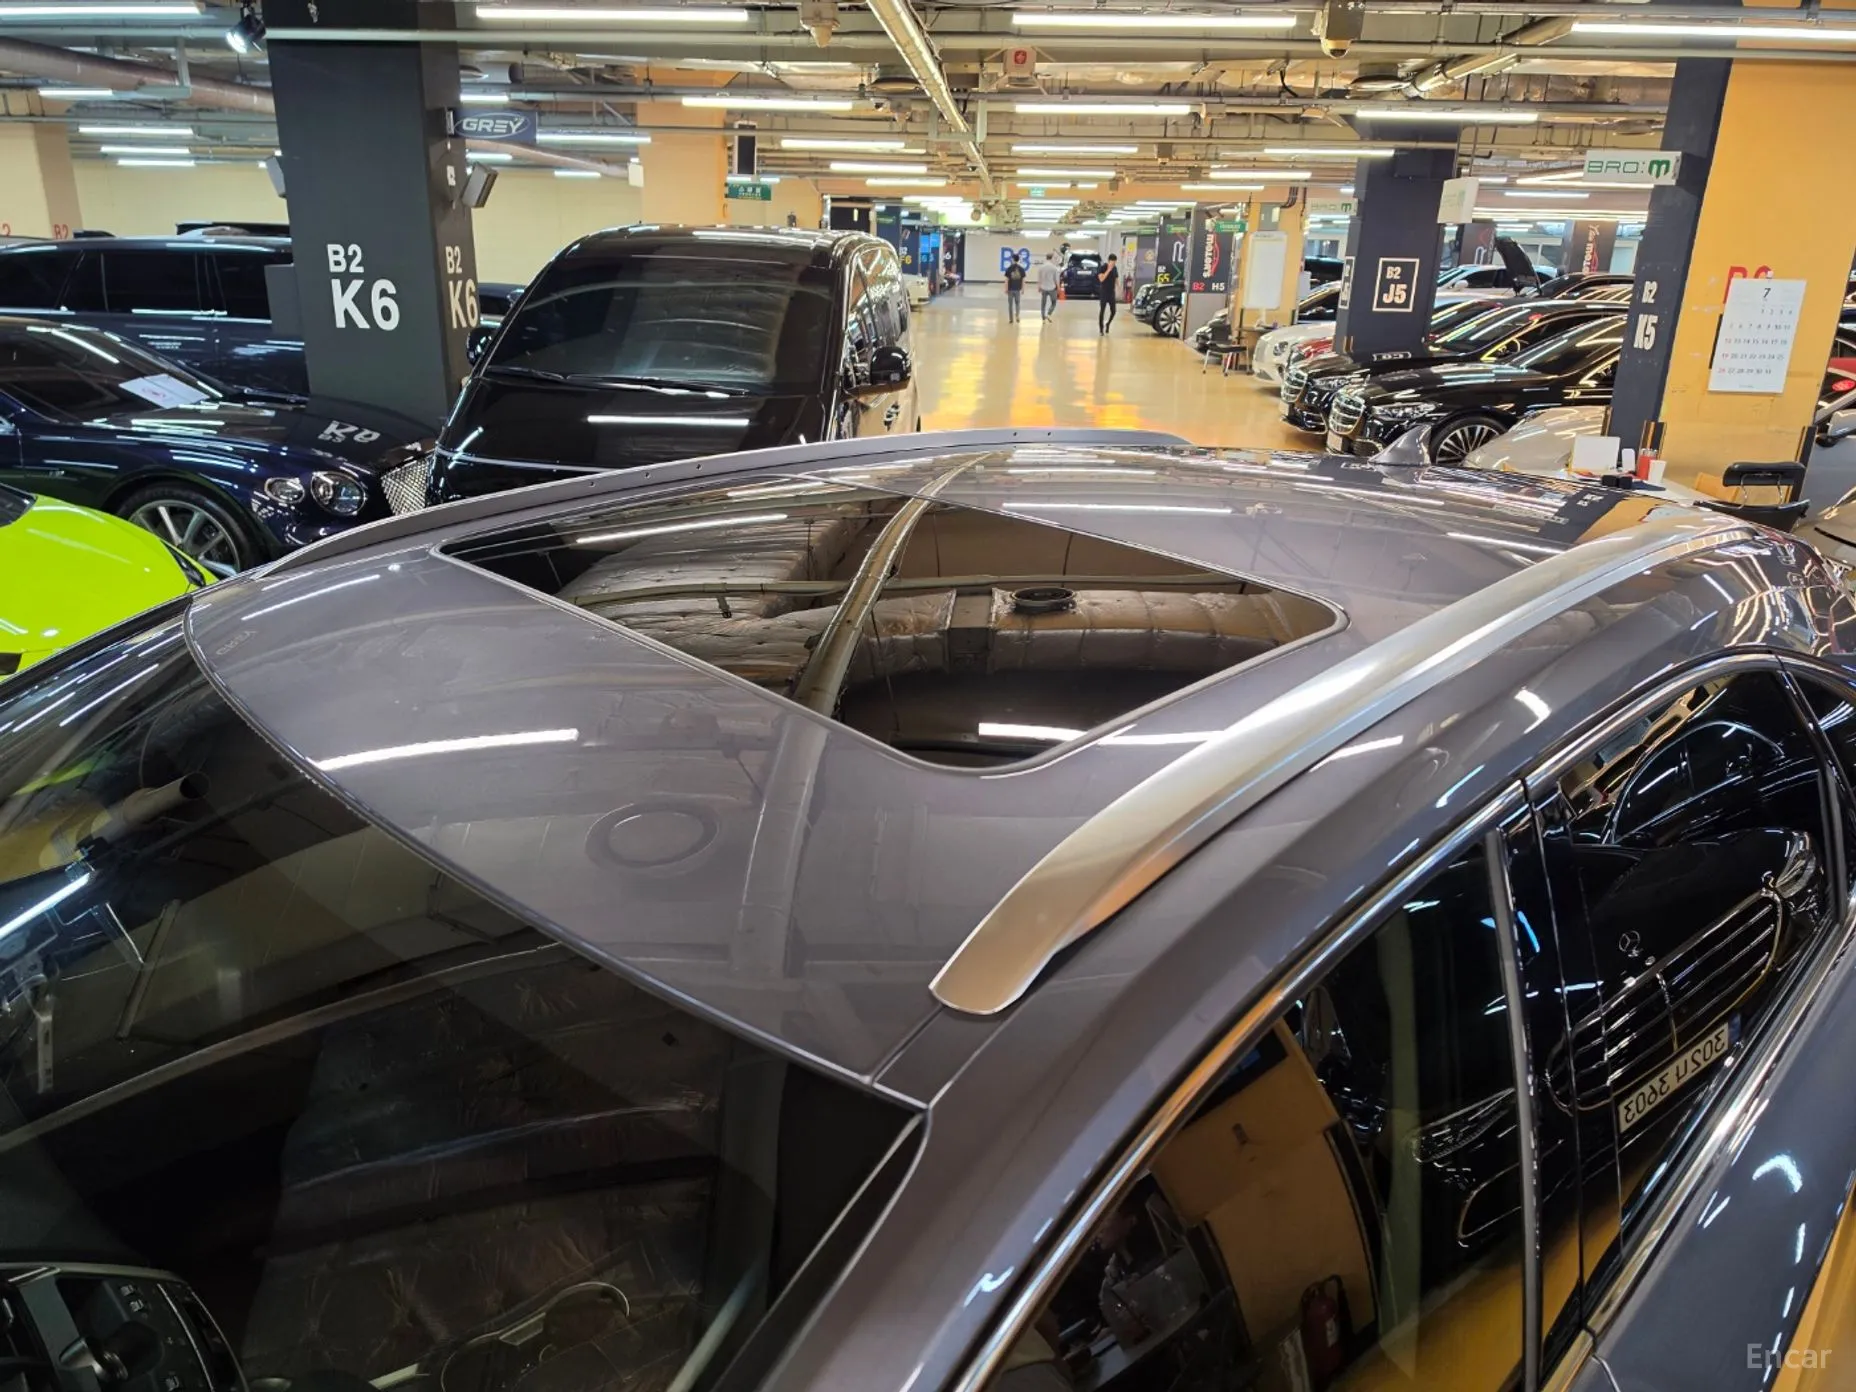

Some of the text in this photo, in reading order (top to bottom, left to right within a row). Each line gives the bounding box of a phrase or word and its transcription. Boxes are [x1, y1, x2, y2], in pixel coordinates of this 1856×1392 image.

[462, 117, 525, 134] GREY
[327, 244, 364, 273] B2
[445, 246, 462, 274] B2
[1386, 266, 1401, 279] B2
[1192, 281, 1225, 292] B2 H5
[1382, 284, 1407, 304] J5
[1641, 281, 1658, 303] B2
[1763, 287, 1772, 299] 7
[331, 278, 400, 331] K6
[449, 278, 478, 329] K6
[1633, 313, 1659, 350] K5
